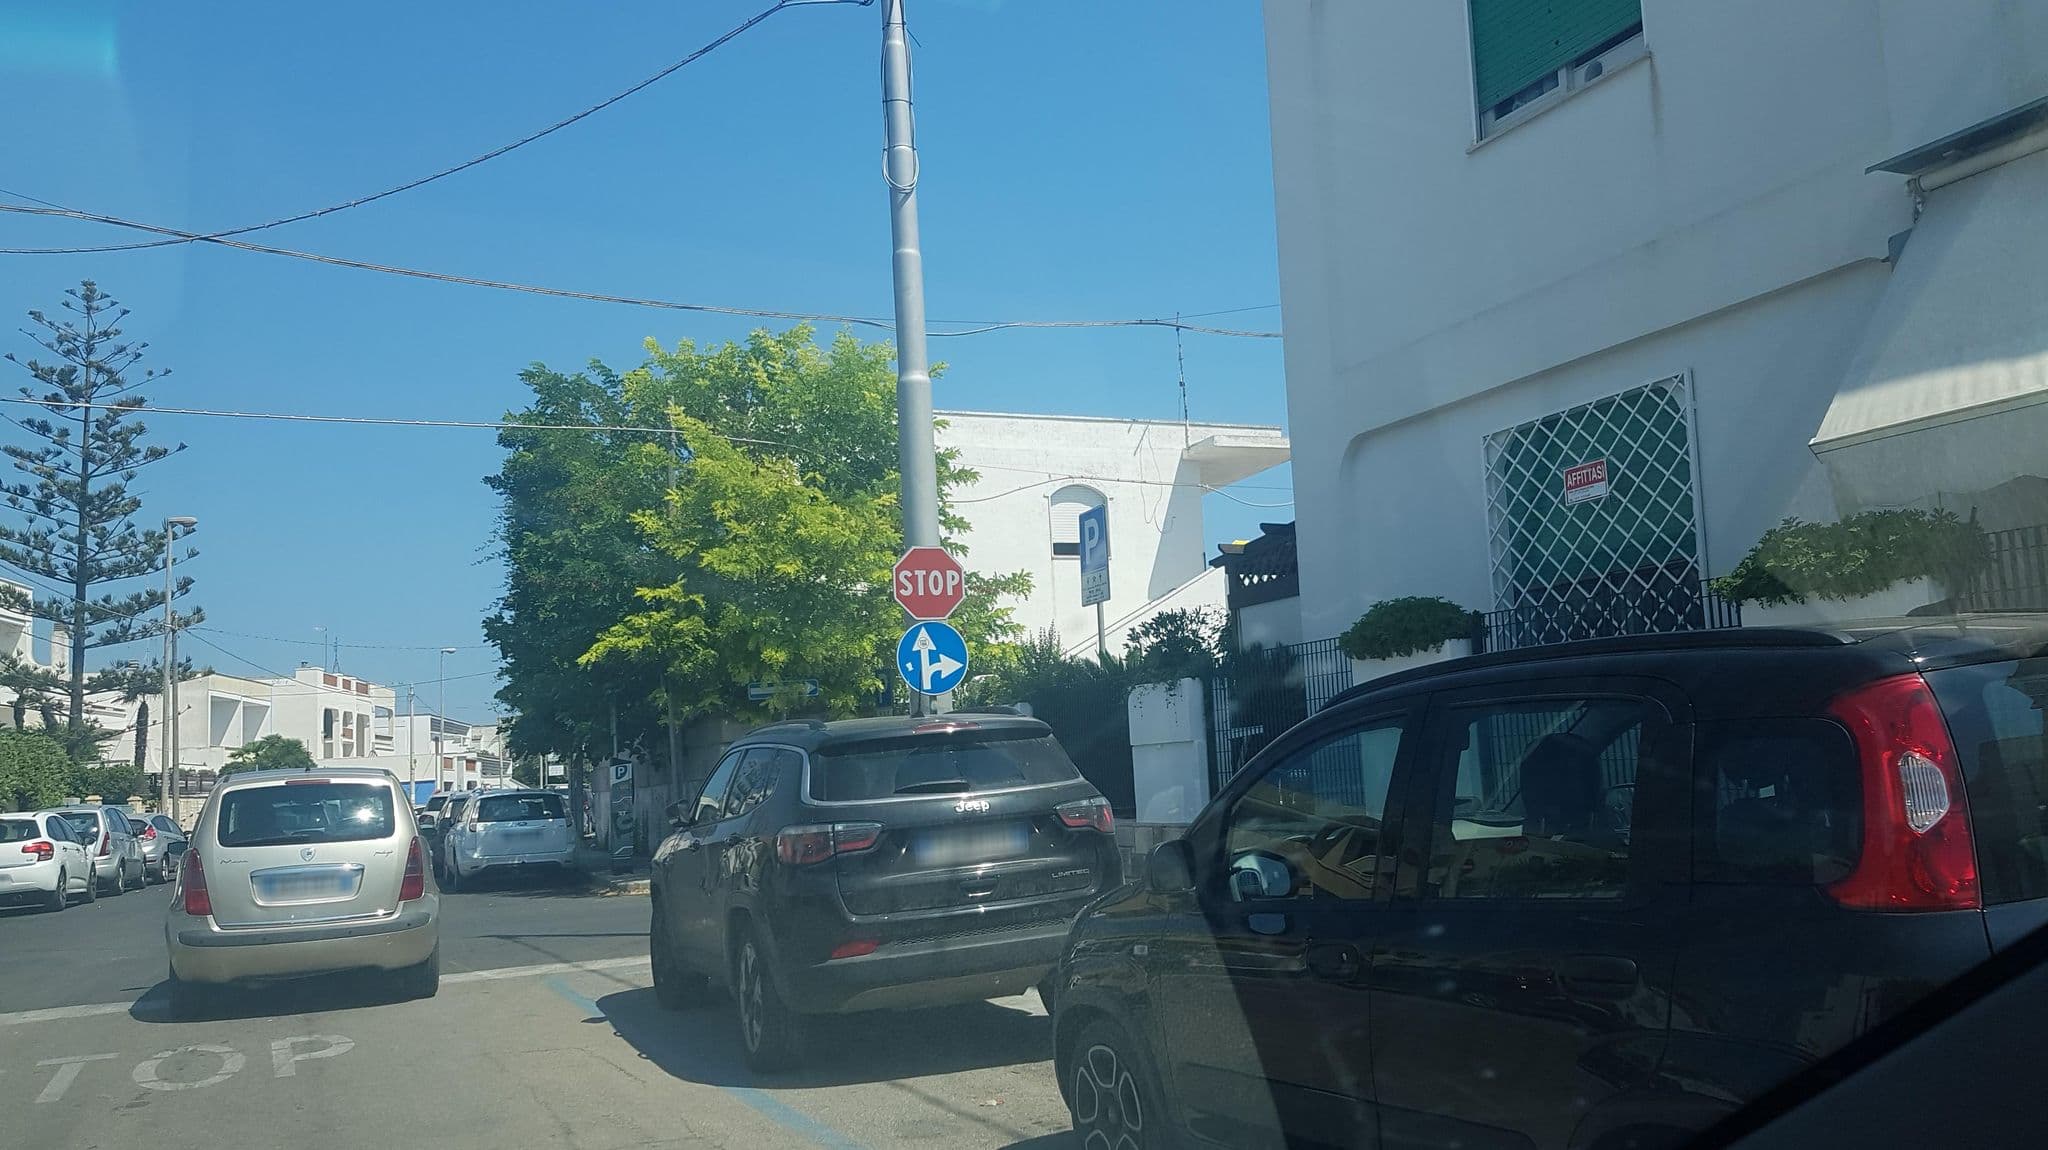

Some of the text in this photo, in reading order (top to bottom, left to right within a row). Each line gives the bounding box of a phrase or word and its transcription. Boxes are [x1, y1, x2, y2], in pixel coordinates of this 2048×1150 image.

[1567, 464, 1605, 488] AFFITTASI
[1085, 518, 1099, 564] P
[899, 569, 960, 597] STOP
[954, 800, 991, 813] Jeep
[1051, 868, 1090, 879] LIMITED
[0, 1034, 355, 1103] TOP
